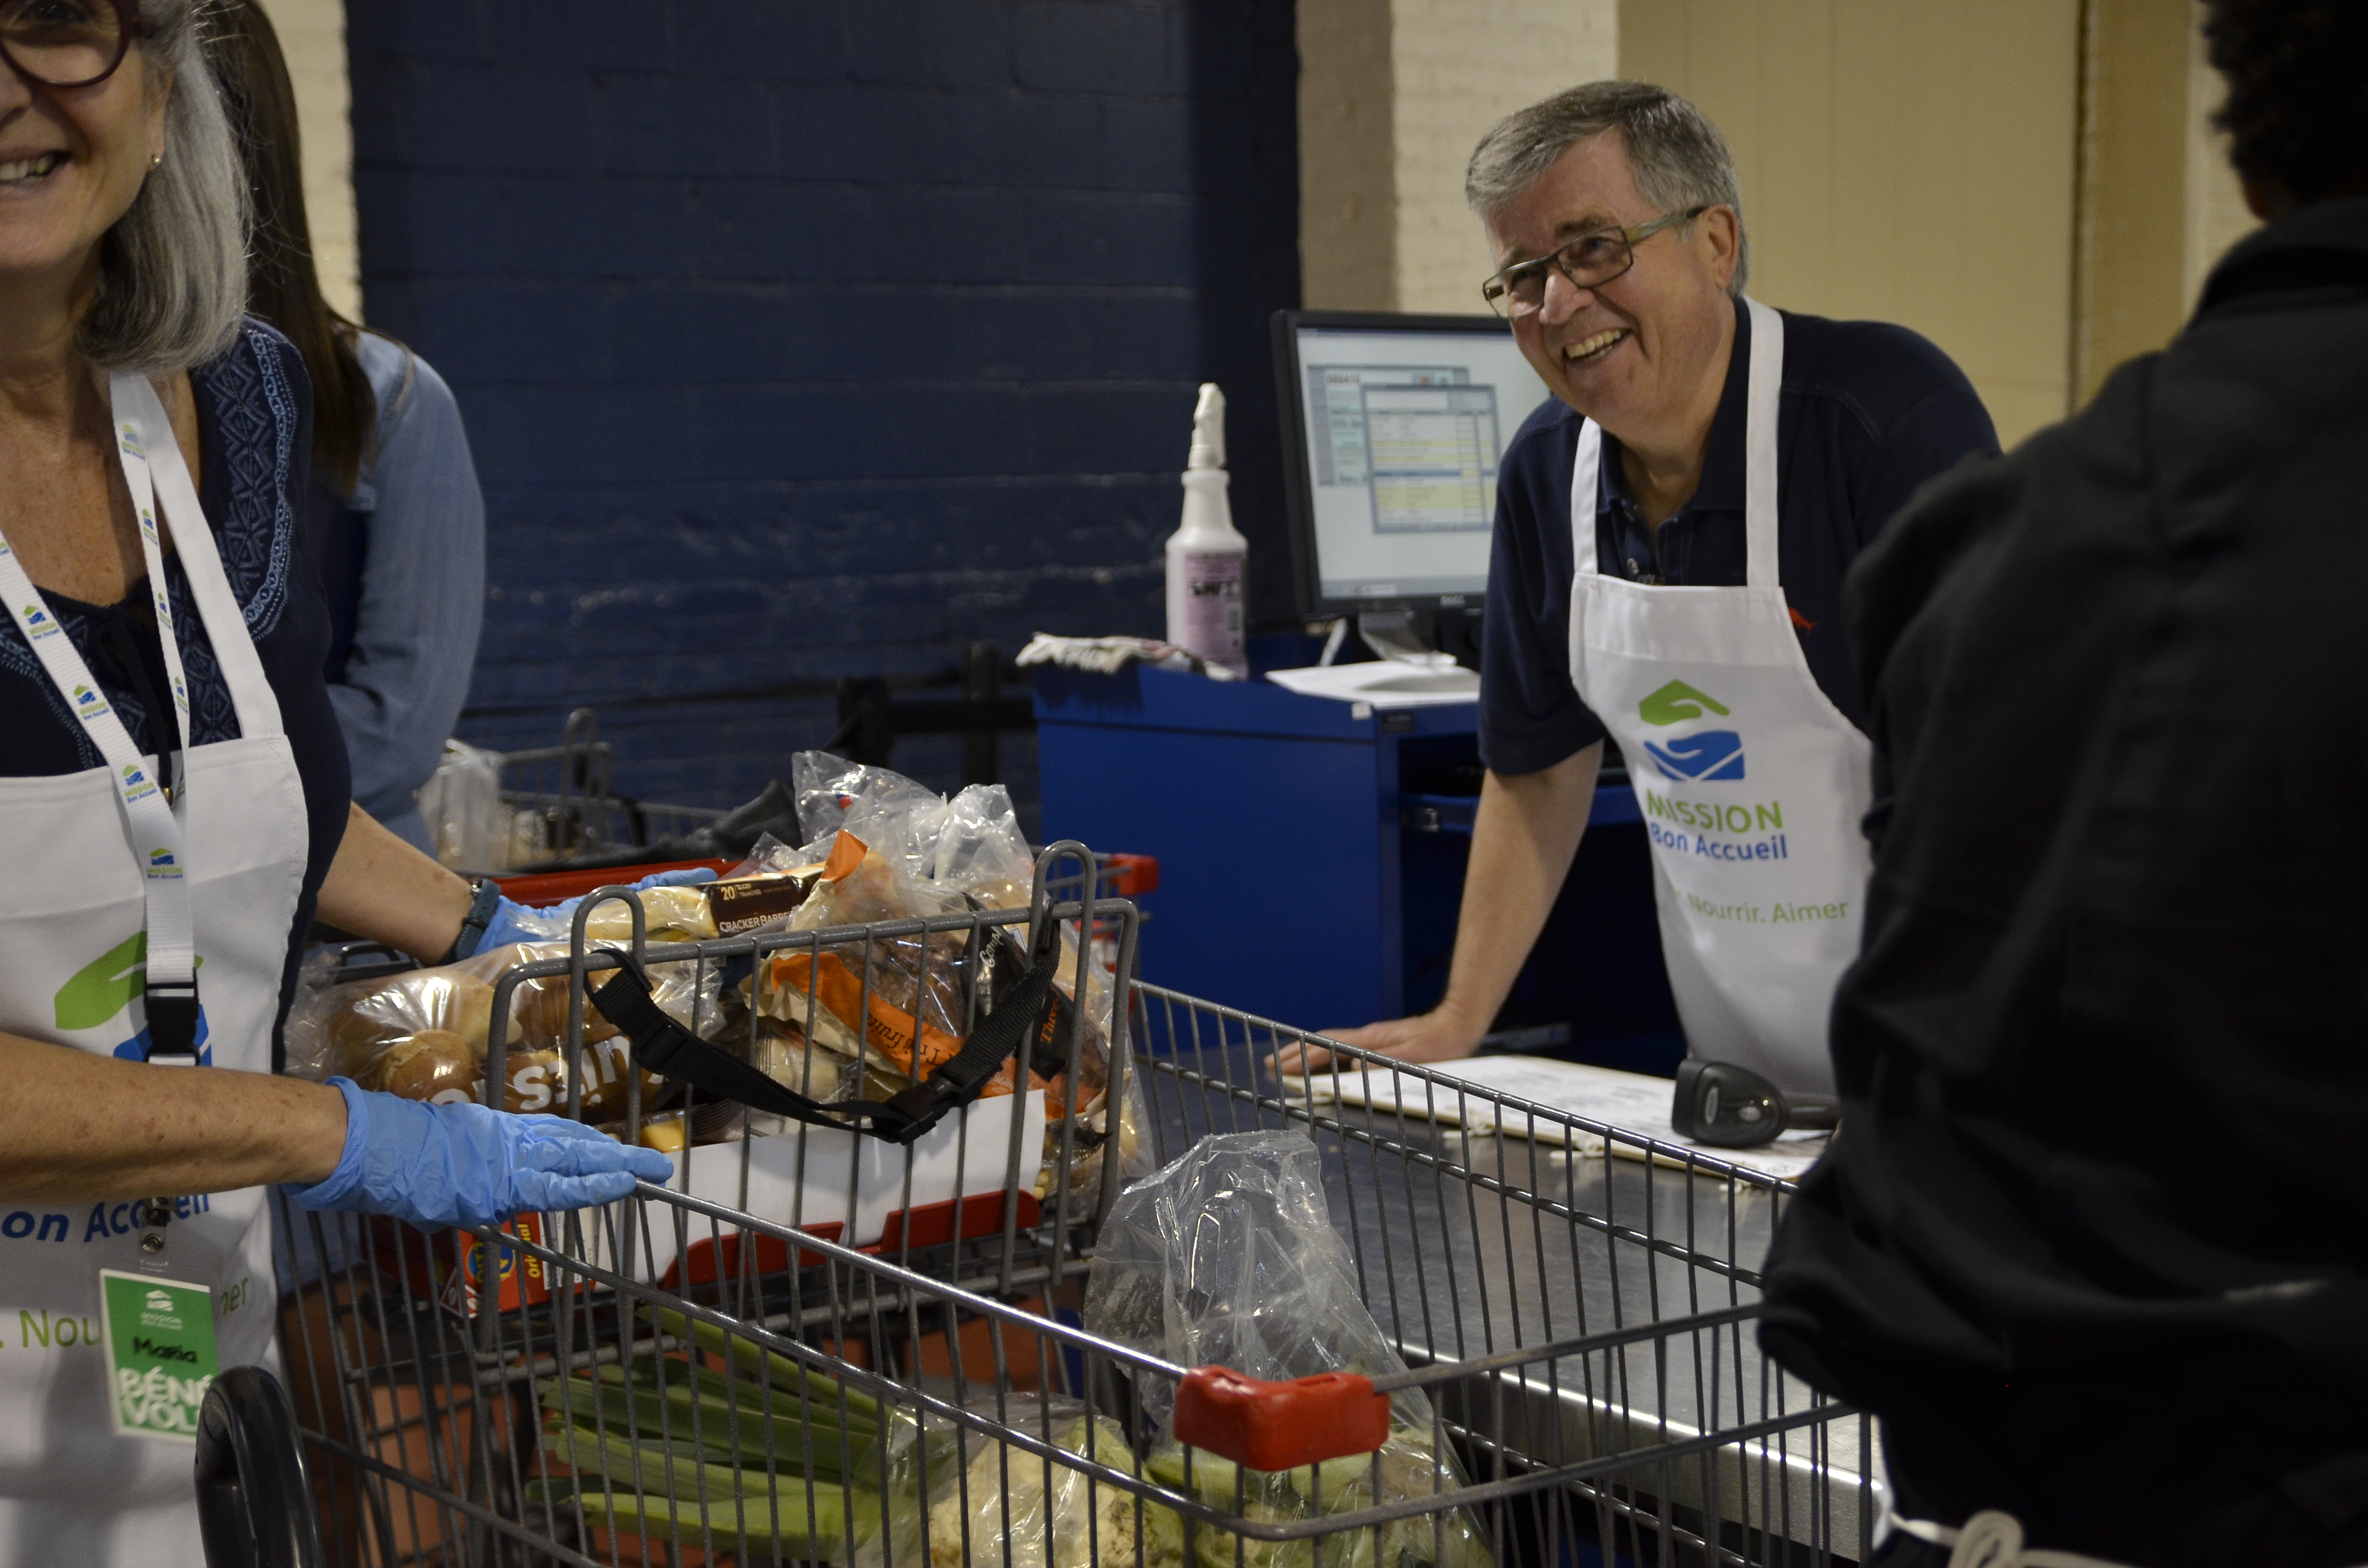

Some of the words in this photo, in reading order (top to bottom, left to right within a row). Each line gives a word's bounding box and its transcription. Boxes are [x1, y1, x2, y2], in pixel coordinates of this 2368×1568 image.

[1647, 789, 1783, 833] MISSION
[1650, 821, 1689, 852] Bon
[1696, 833, 1788, 860] Accueil
[721, 886, 736, 900] 20
[1773, 902, 1849, 923] Aimer
[719, 917, 761, 932] CRACKER
